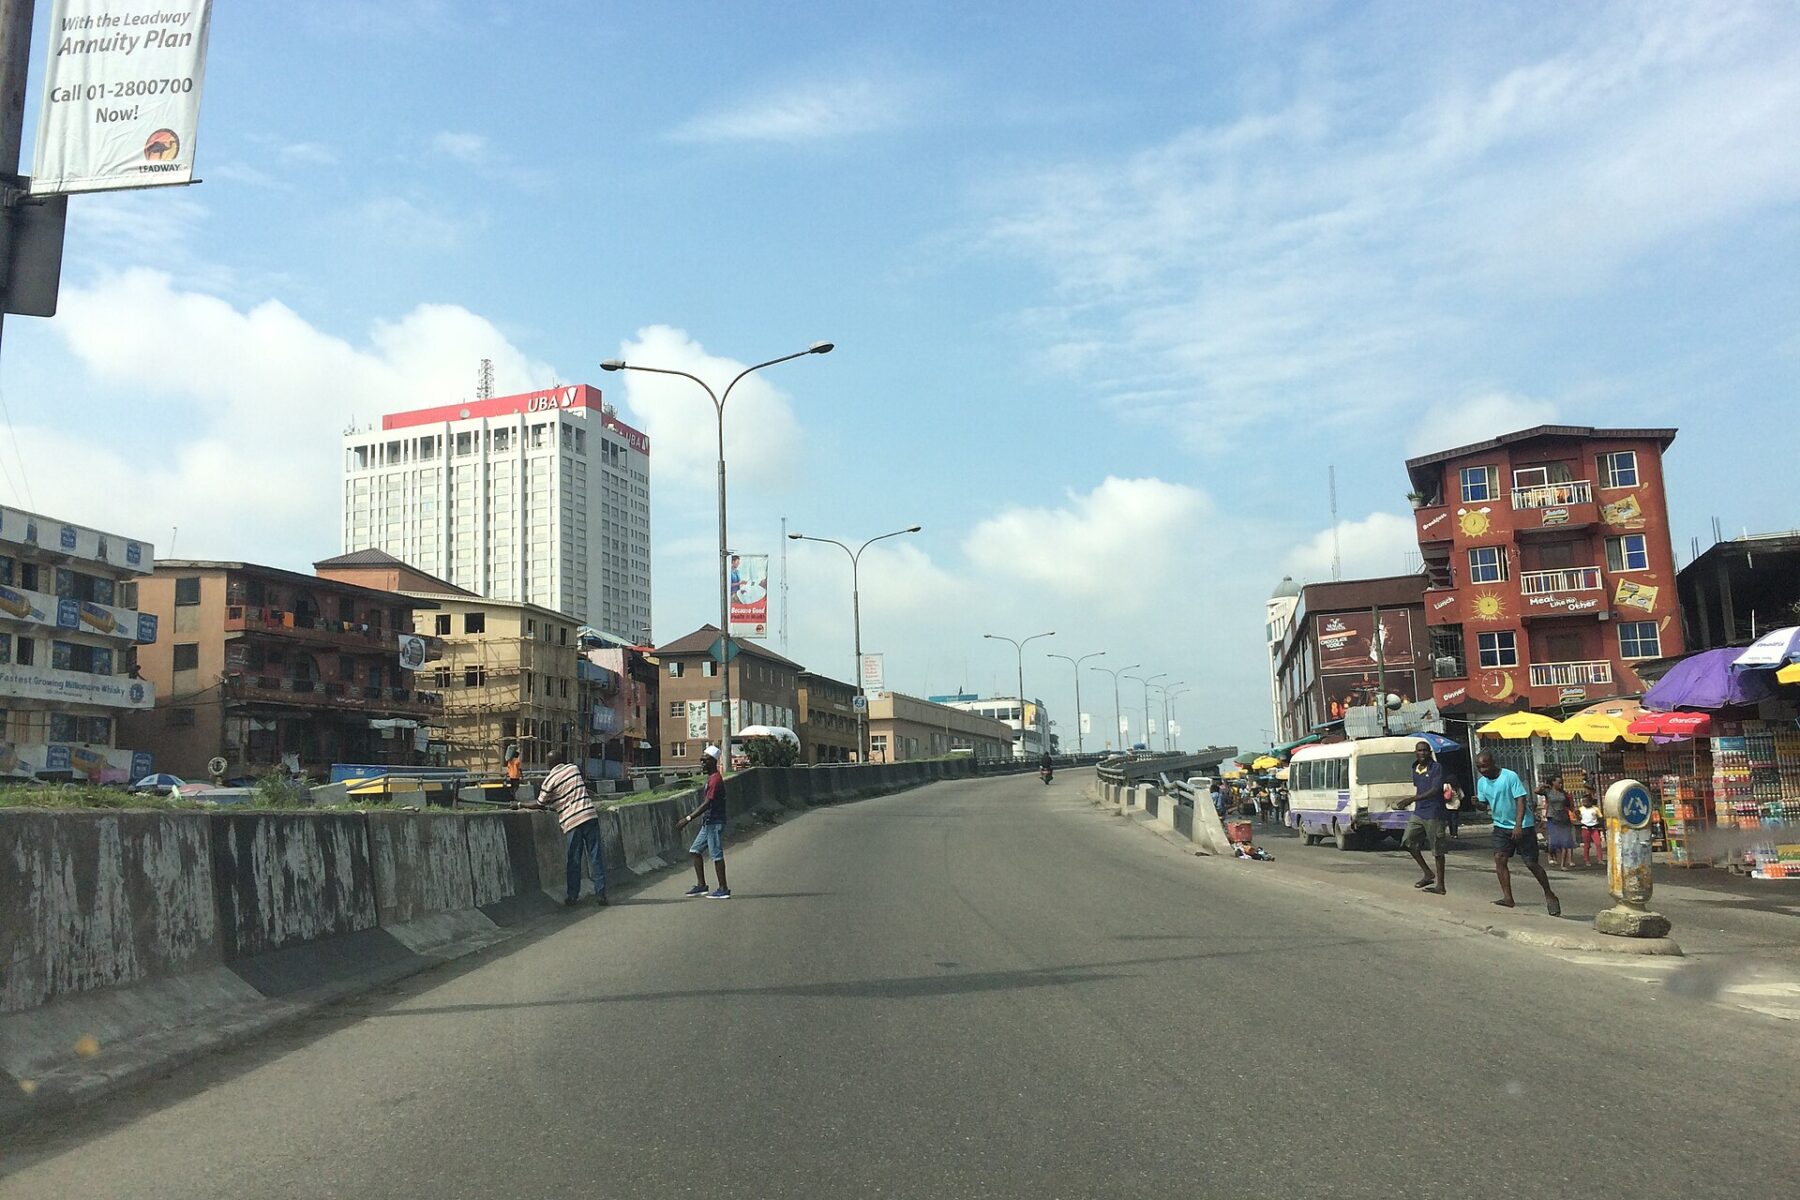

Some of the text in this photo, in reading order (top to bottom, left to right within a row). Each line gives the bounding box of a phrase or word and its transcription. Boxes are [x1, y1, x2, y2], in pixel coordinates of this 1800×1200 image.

[61, 10, 192, 31] With the Leadway
[57, 28, 192, 56] Annuity Plan
[50, 77, 193, 103] Call 01-2800700
[95, 105, 140, 124] Now!
[139, 164, 181, 173] LEADWAY
[527, 395, 559, 413] UBA
[625, 431, 642, 448] UBA
[1433, 596, 1455, 610] Lunch
[1529, 594, 1555, 606] Meal
[1568, 600, 1597, 611] Other
[33, 676, 64, 690] Growing
[102, 684, 125, 697] Whisky
